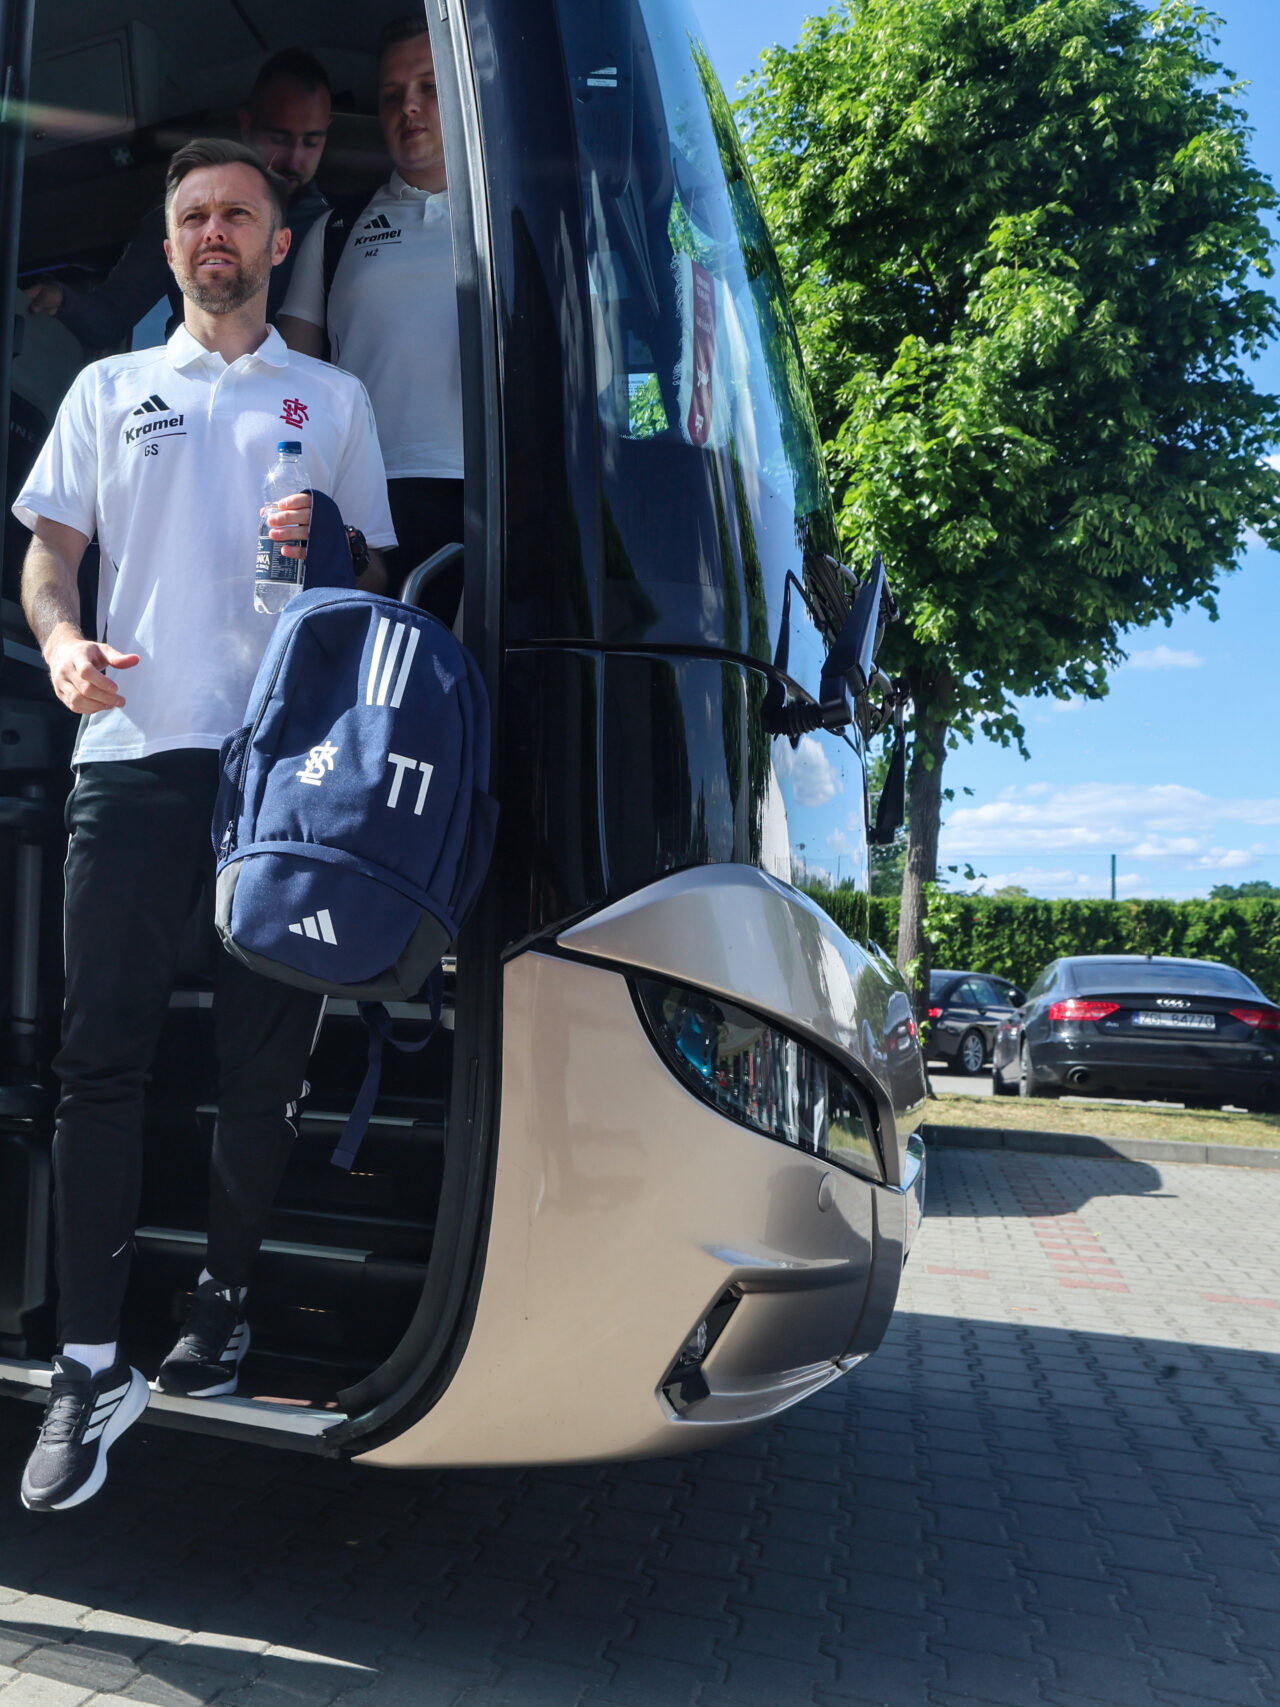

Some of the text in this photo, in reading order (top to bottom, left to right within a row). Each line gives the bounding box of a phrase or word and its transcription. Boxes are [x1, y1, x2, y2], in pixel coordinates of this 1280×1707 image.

[354, 229, 401, 247] Kramel
[125, 414, 184, 445] Kramel
[145, 444, 159, 457] GS
[387, 752, 434, 816] T1
